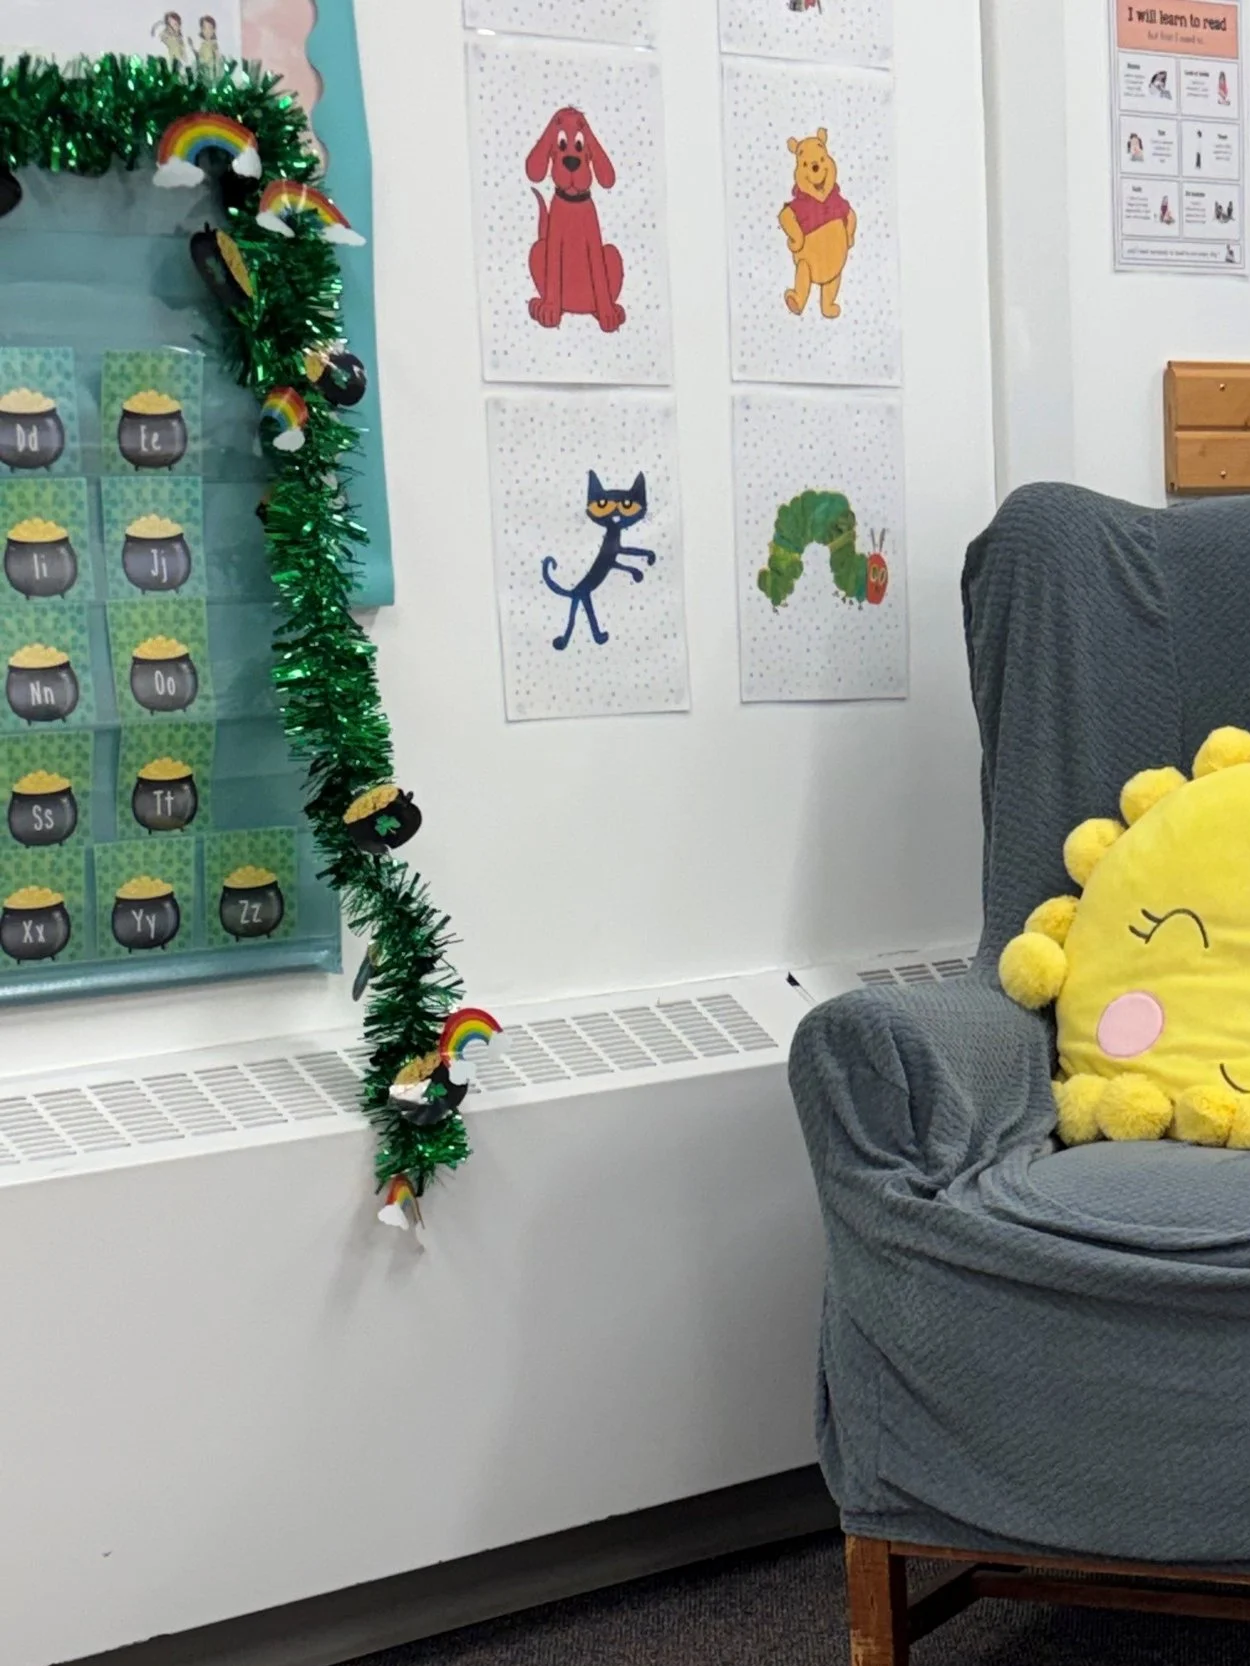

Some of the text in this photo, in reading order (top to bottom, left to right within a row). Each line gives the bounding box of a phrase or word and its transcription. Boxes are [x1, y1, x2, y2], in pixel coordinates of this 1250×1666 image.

[1127, 6, 1227, 32] I will learn to read
[16, 424, 38, 452] Dd
[140, 424, 162, 451] Ee
[150, 549, 168, 583] Jj
[30, 681, 56, 706] Nn
[154, 670, 176, 696] Oo
[153, 790, 175, 817] Tt
[32, 804, 55, 831] Ss
[132, 909, 157, 939] Yy
[239, 900, 263, 924] Zz
[22, 920, 46, 944] Xx
